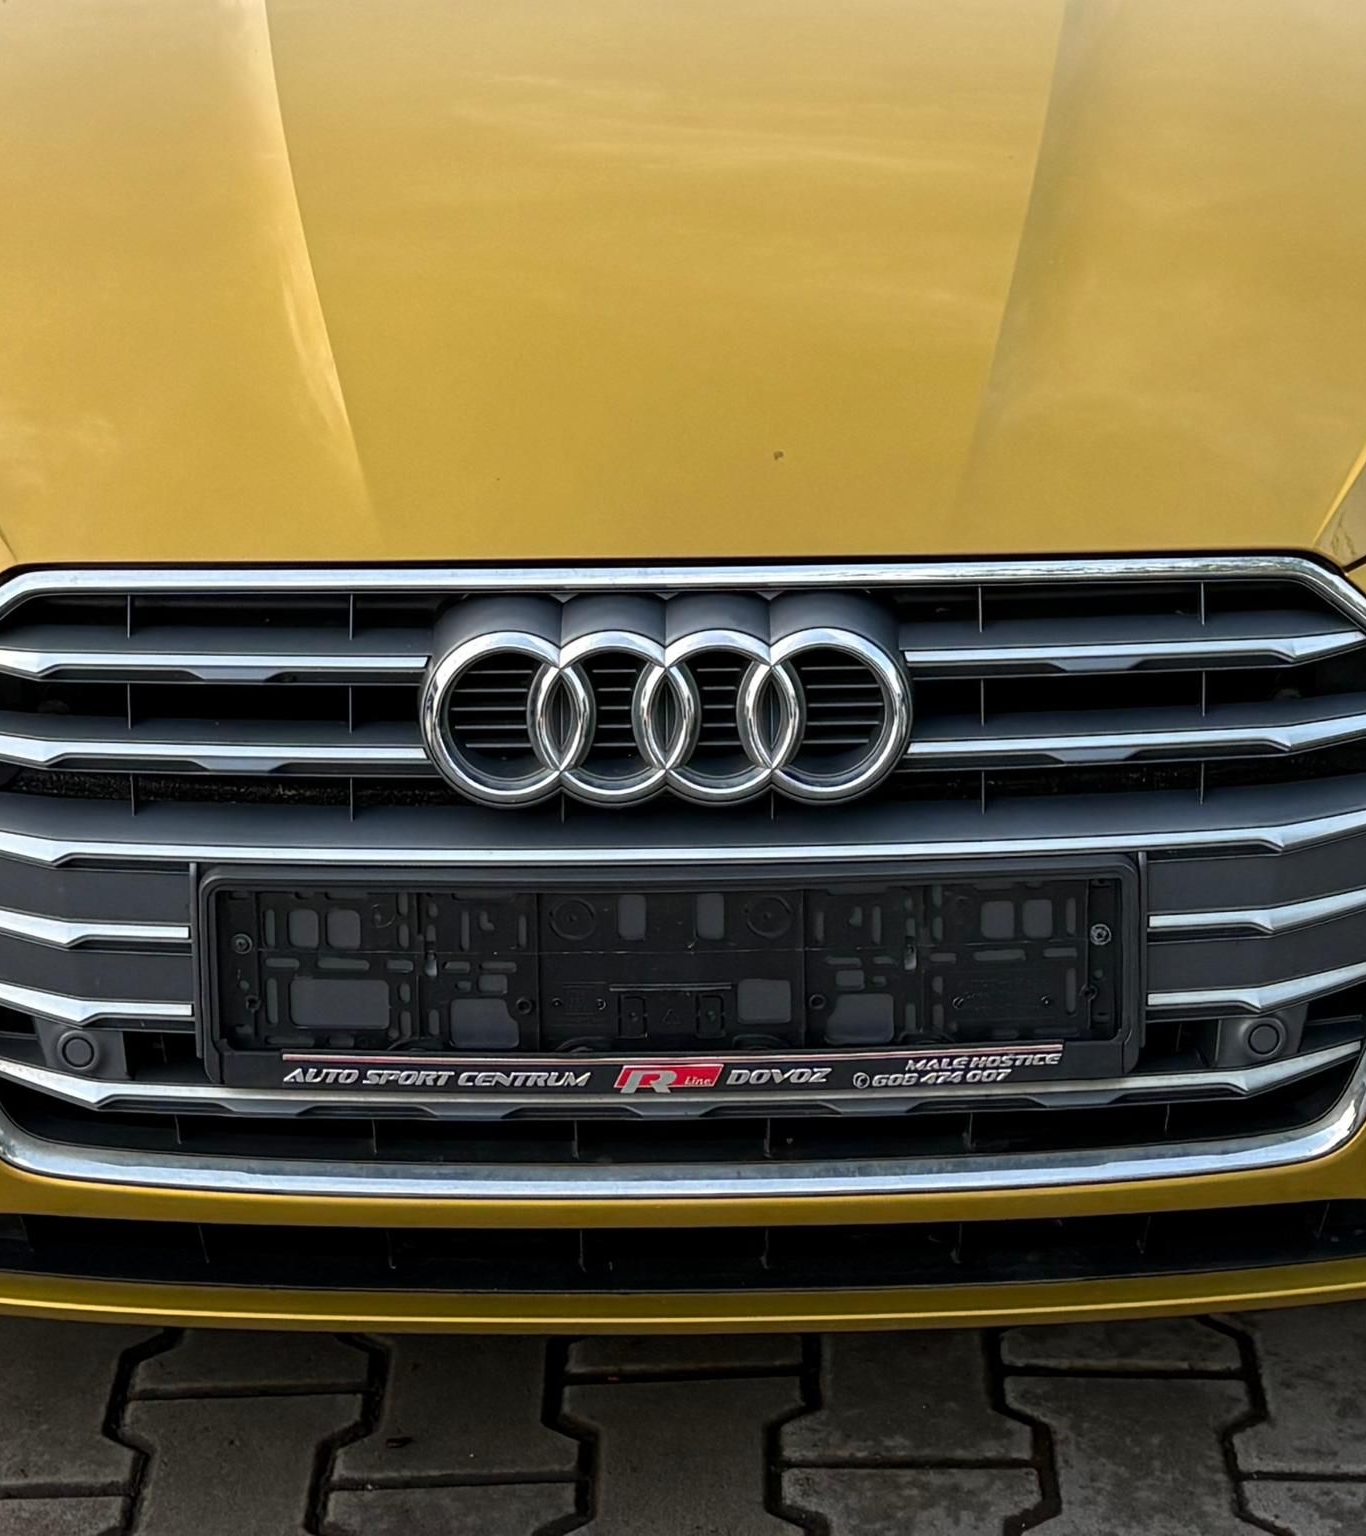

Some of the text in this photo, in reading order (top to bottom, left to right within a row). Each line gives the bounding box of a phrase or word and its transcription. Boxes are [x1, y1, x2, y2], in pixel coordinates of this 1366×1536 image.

[283, 1067, 591, 1087] AUTO SPORT CENTRUM
[620, 1069, 712, 1093] R Line
[726, 1068, 832, 1085] DOVOZ
[920, 1071, 962, 1084] 474
[966, 1069, 1012, 1082] 007
